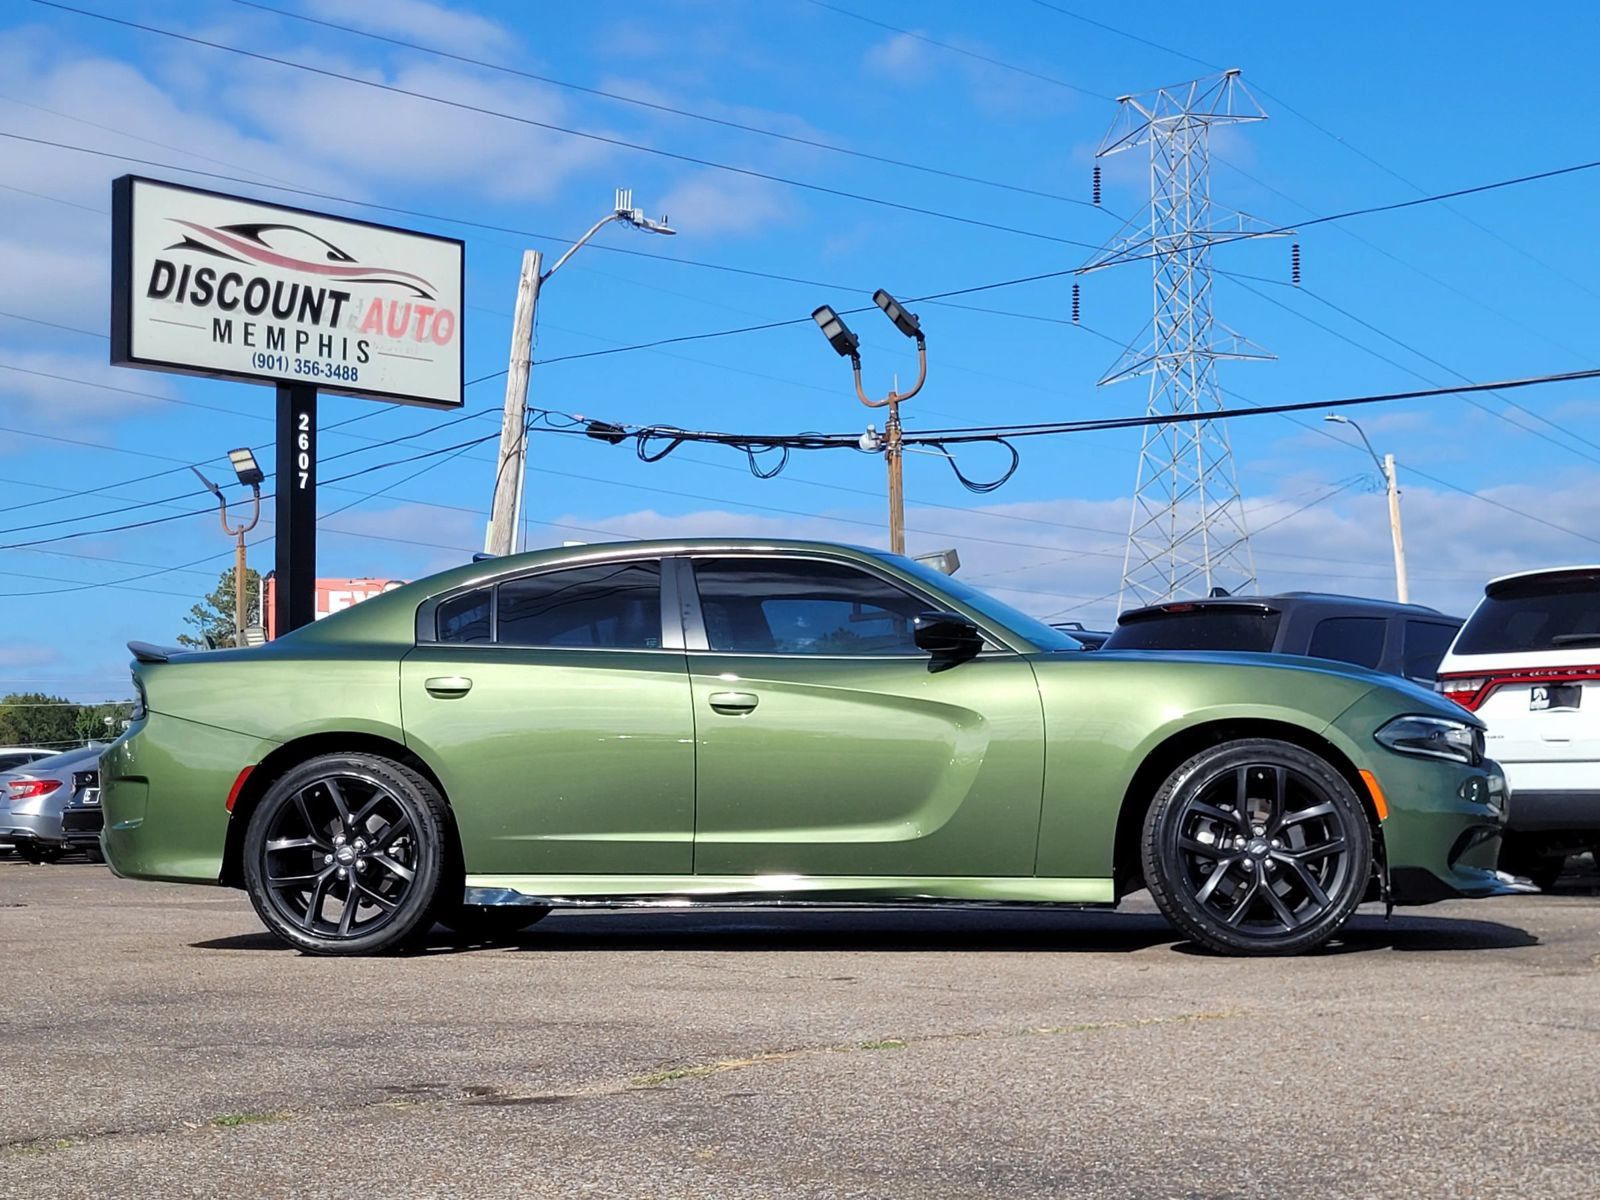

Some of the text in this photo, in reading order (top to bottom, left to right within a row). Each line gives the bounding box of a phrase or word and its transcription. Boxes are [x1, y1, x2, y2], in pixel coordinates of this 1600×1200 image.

[147, 259, 351, 329] DISCOUNT
[360, 297, 455, 346] AUTO
[212, 318, 370, 364] MEMPHIS
[252, 351, 359, 382] (901) 356-3488
[298, 414, 309, 489] 2607
